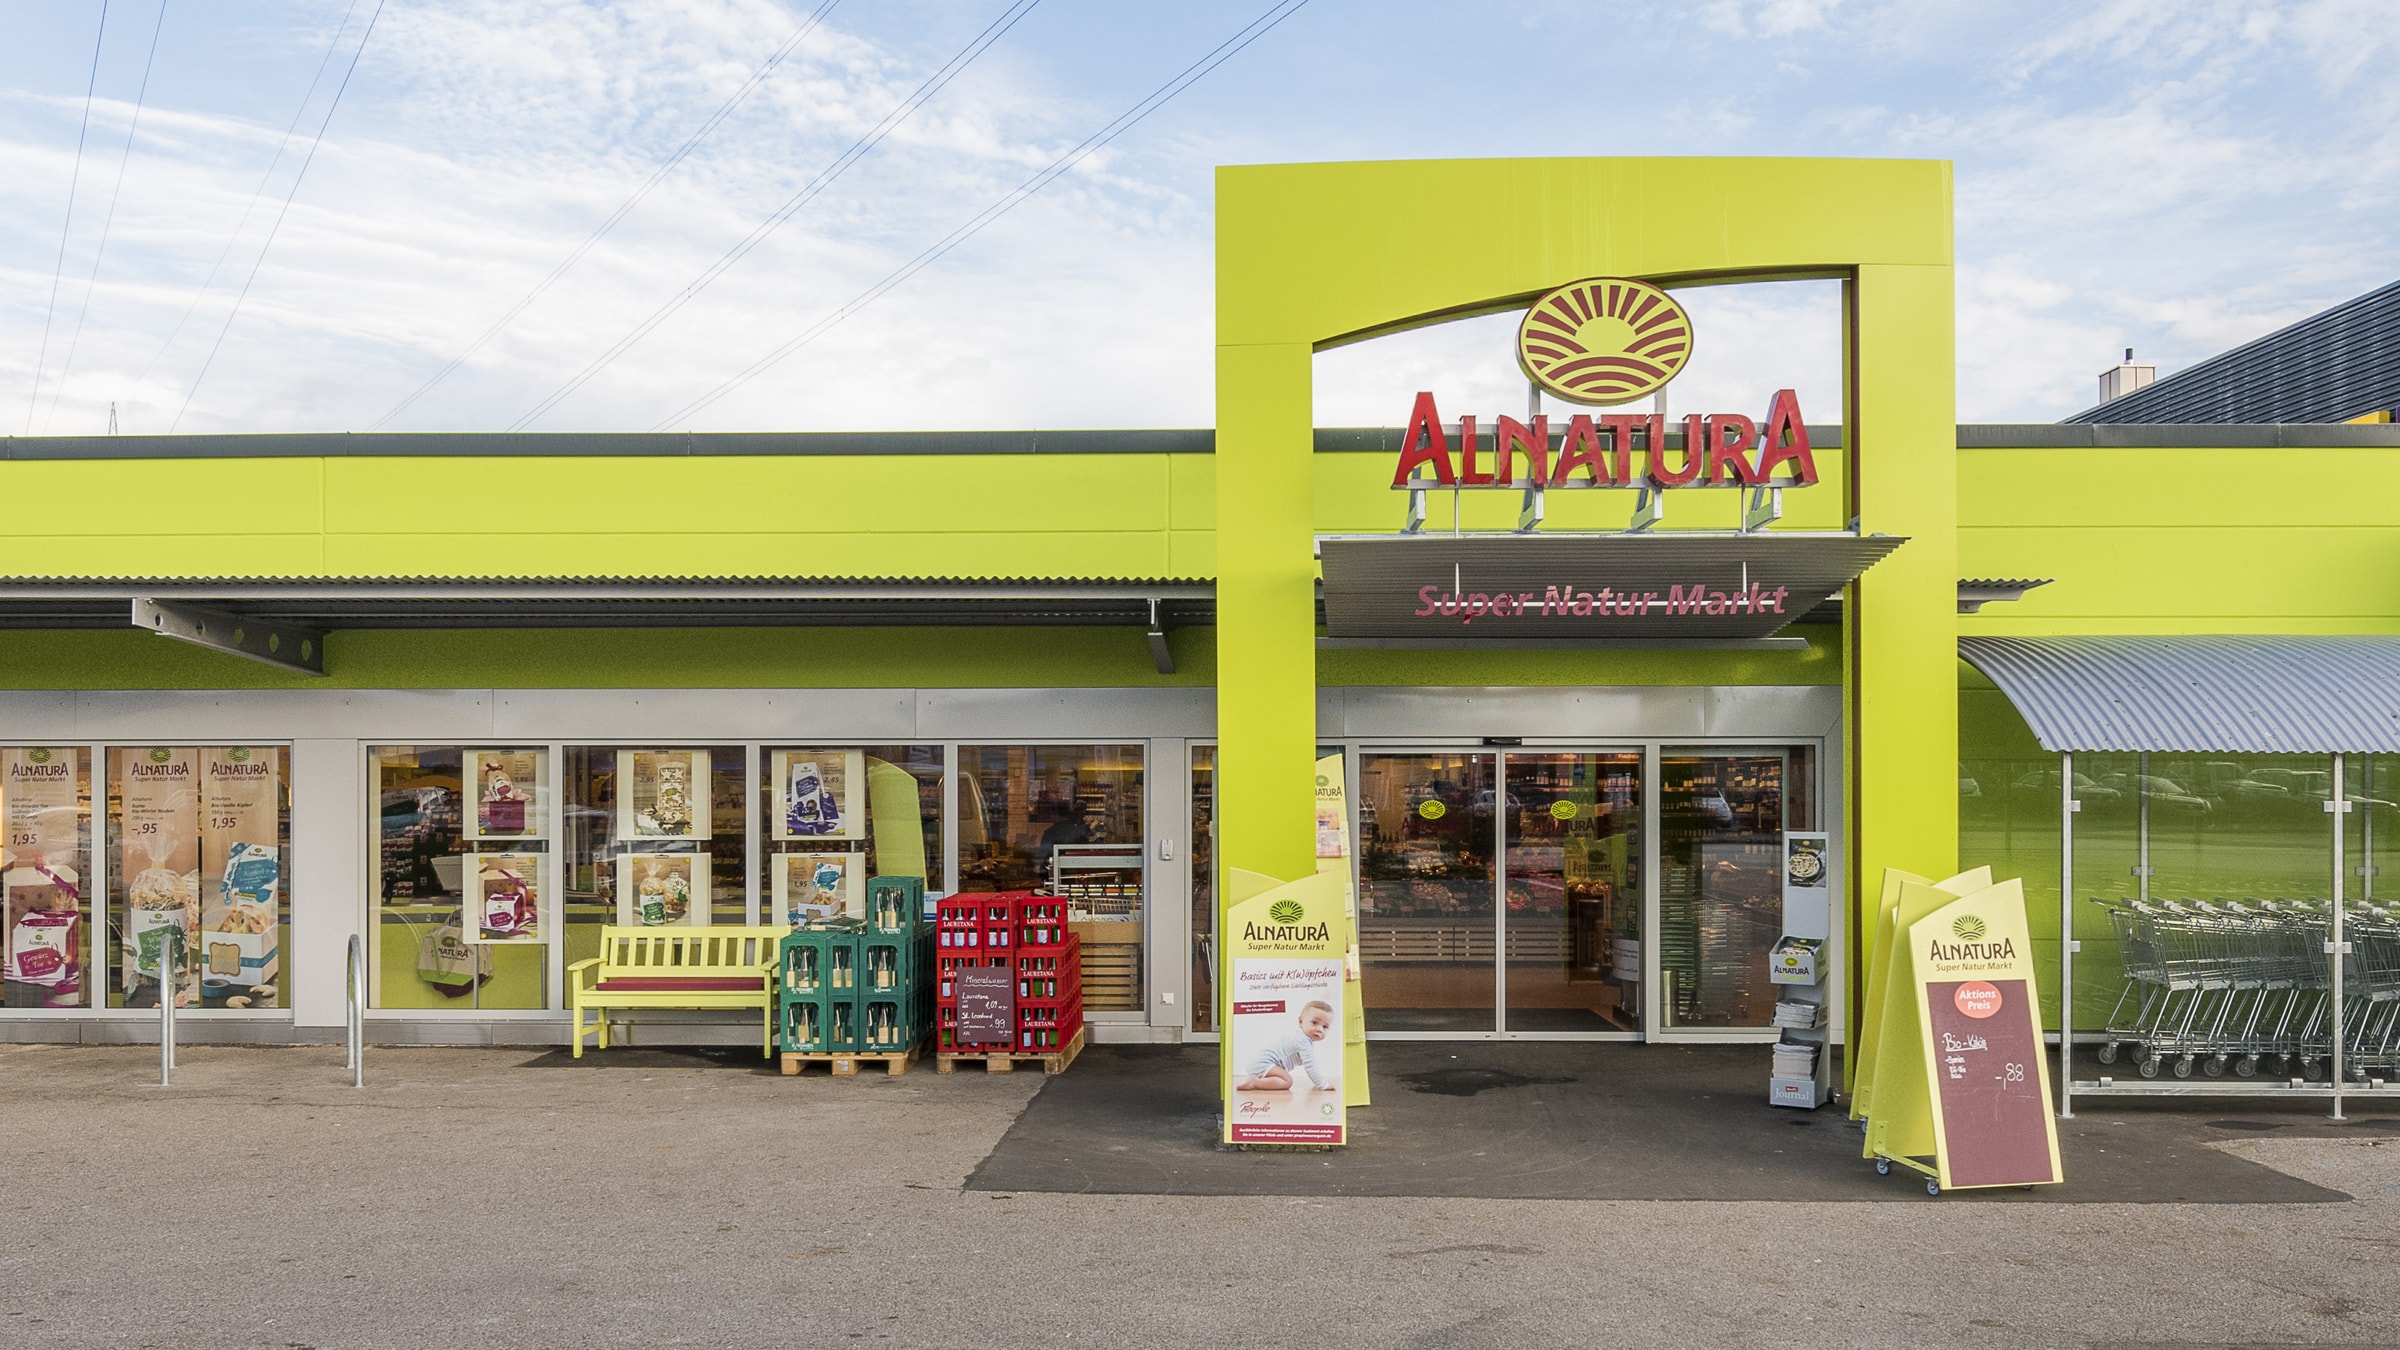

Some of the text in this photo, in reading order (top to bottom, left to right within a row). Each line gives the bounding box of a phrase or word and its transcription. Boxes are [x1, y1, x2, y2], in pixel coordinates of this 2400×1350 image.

[1391, 389, 1819, 489] ALNATURA
[1415, 581, 1788, 625] Super Natur Markt
[11, 762, 69, 776] ALNATURA
[131, 762, 189, 776] ALNATURA
[210, 761, 269, 775] ALNATURA
[1315, 786, 1342, 796] ATURA
[212, 817, 237, 829] 1,95
[12, 834, 37, 846] 1,95
[1244, 921, 1330, 941] ALNATURA
[431, 948, 468, 958] NATURA
[1248, 943, 1272, 952] Super
[1930, 937, 2016, 960] ALNATURA
[1774, 965, 1810, 976] ALNATURA
[1936, 964, 1960, 972] Super
[1987, 962, 2012, 970] Markt
[966, 975, 1008, 984] Mineralwasser
[1240, 970, 1267, 981] Basics
[1959, 989, 1996, 1000] Aktions
[1968, 1000, 1992, 1010] Preis
[1775, 1088, 1810, 1100] Journal
